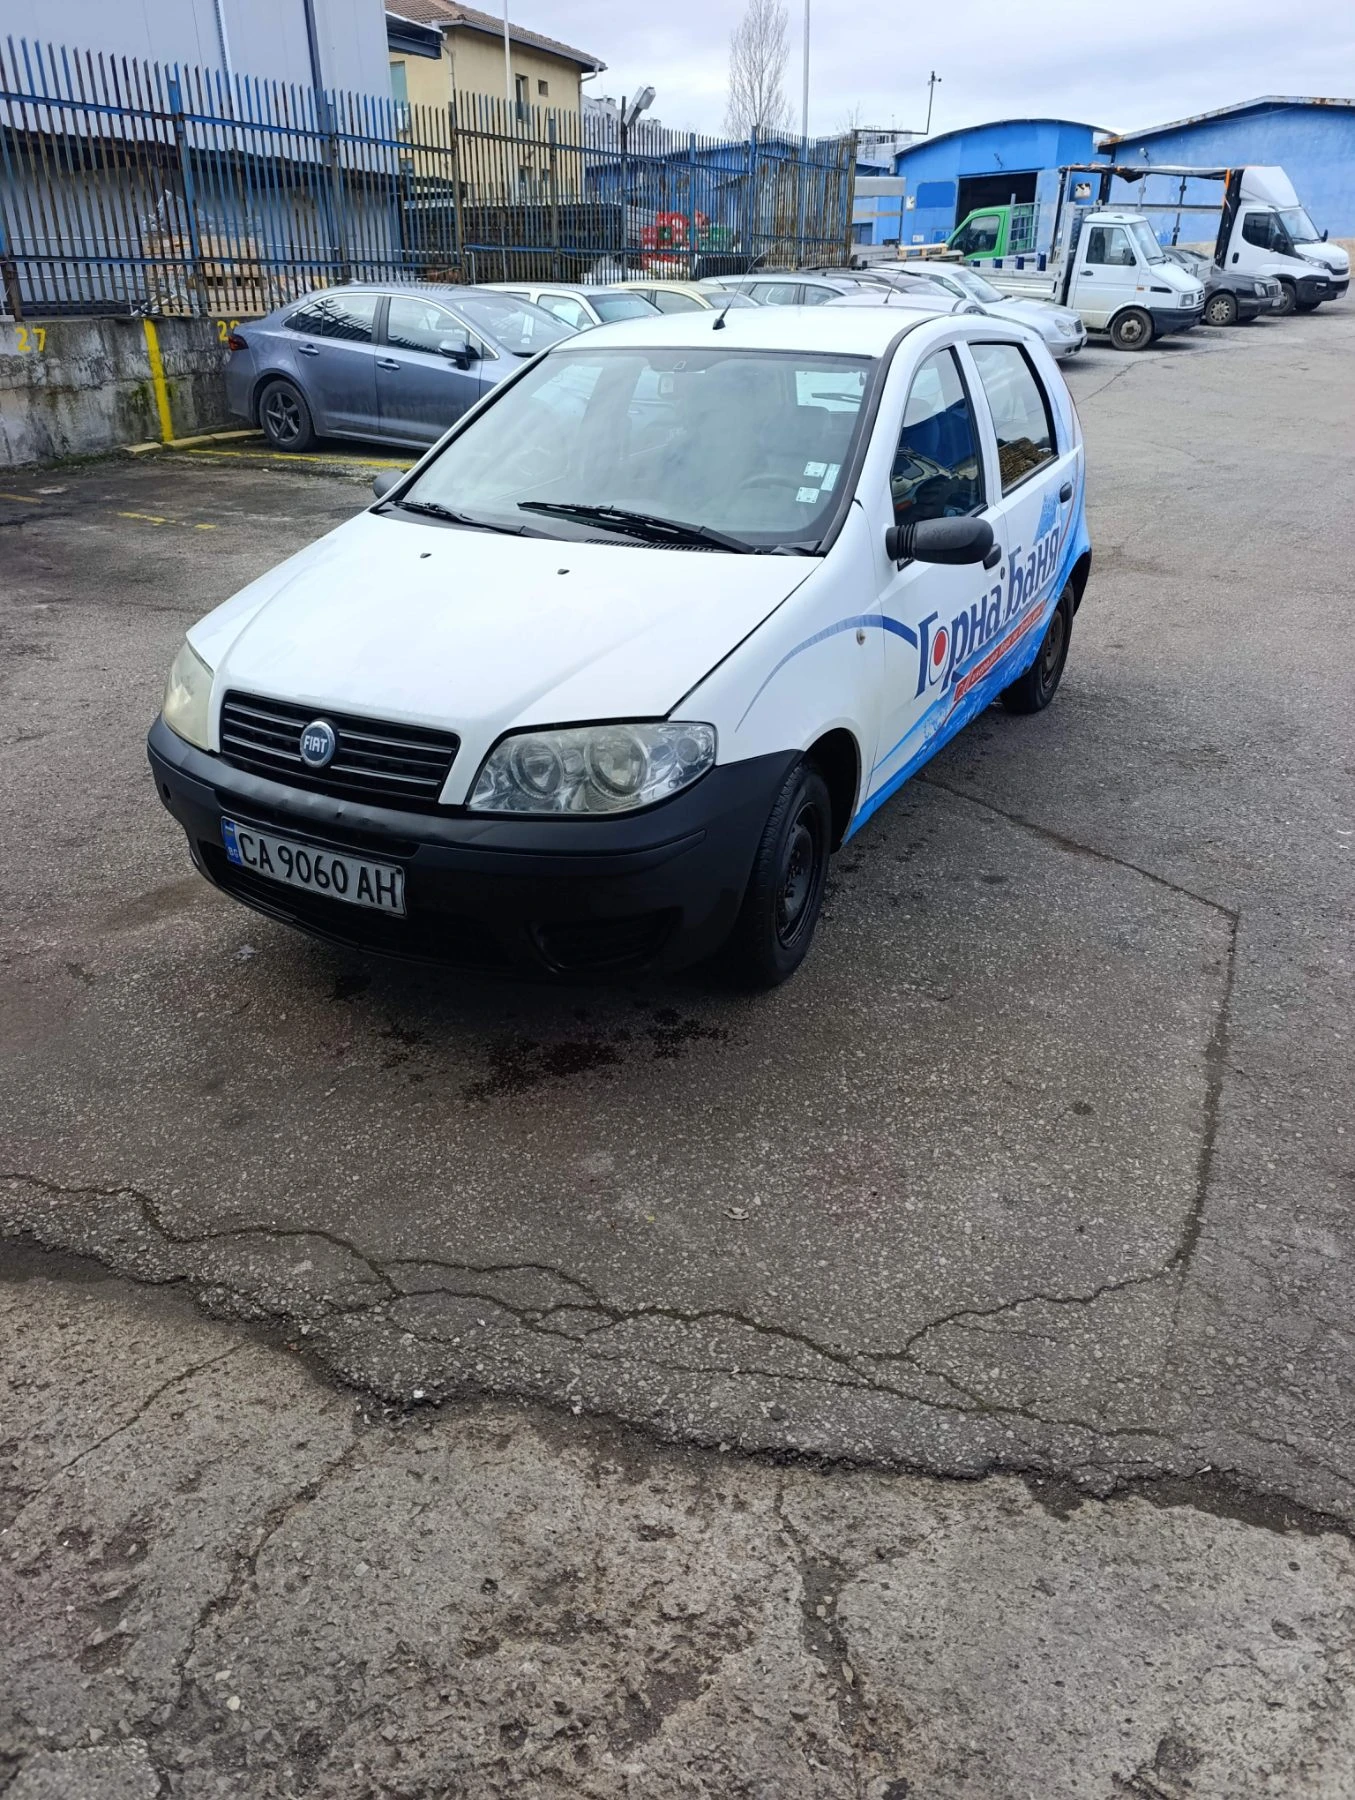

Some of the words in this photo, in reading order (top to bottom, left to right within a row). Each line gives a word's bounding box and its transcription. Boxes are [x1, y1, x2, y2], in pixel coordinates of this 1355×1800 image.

[15, 327, 46, 352] 27
[914, 584, 1002, 700] Горна
[1004, 525, 1060, 622] Баня
[303, 735, 328, 753] FIAT
[238, 832, 275, 874] CA
[277, 845, 349, 894] 9060
[357, 866, 398, 908] AH
